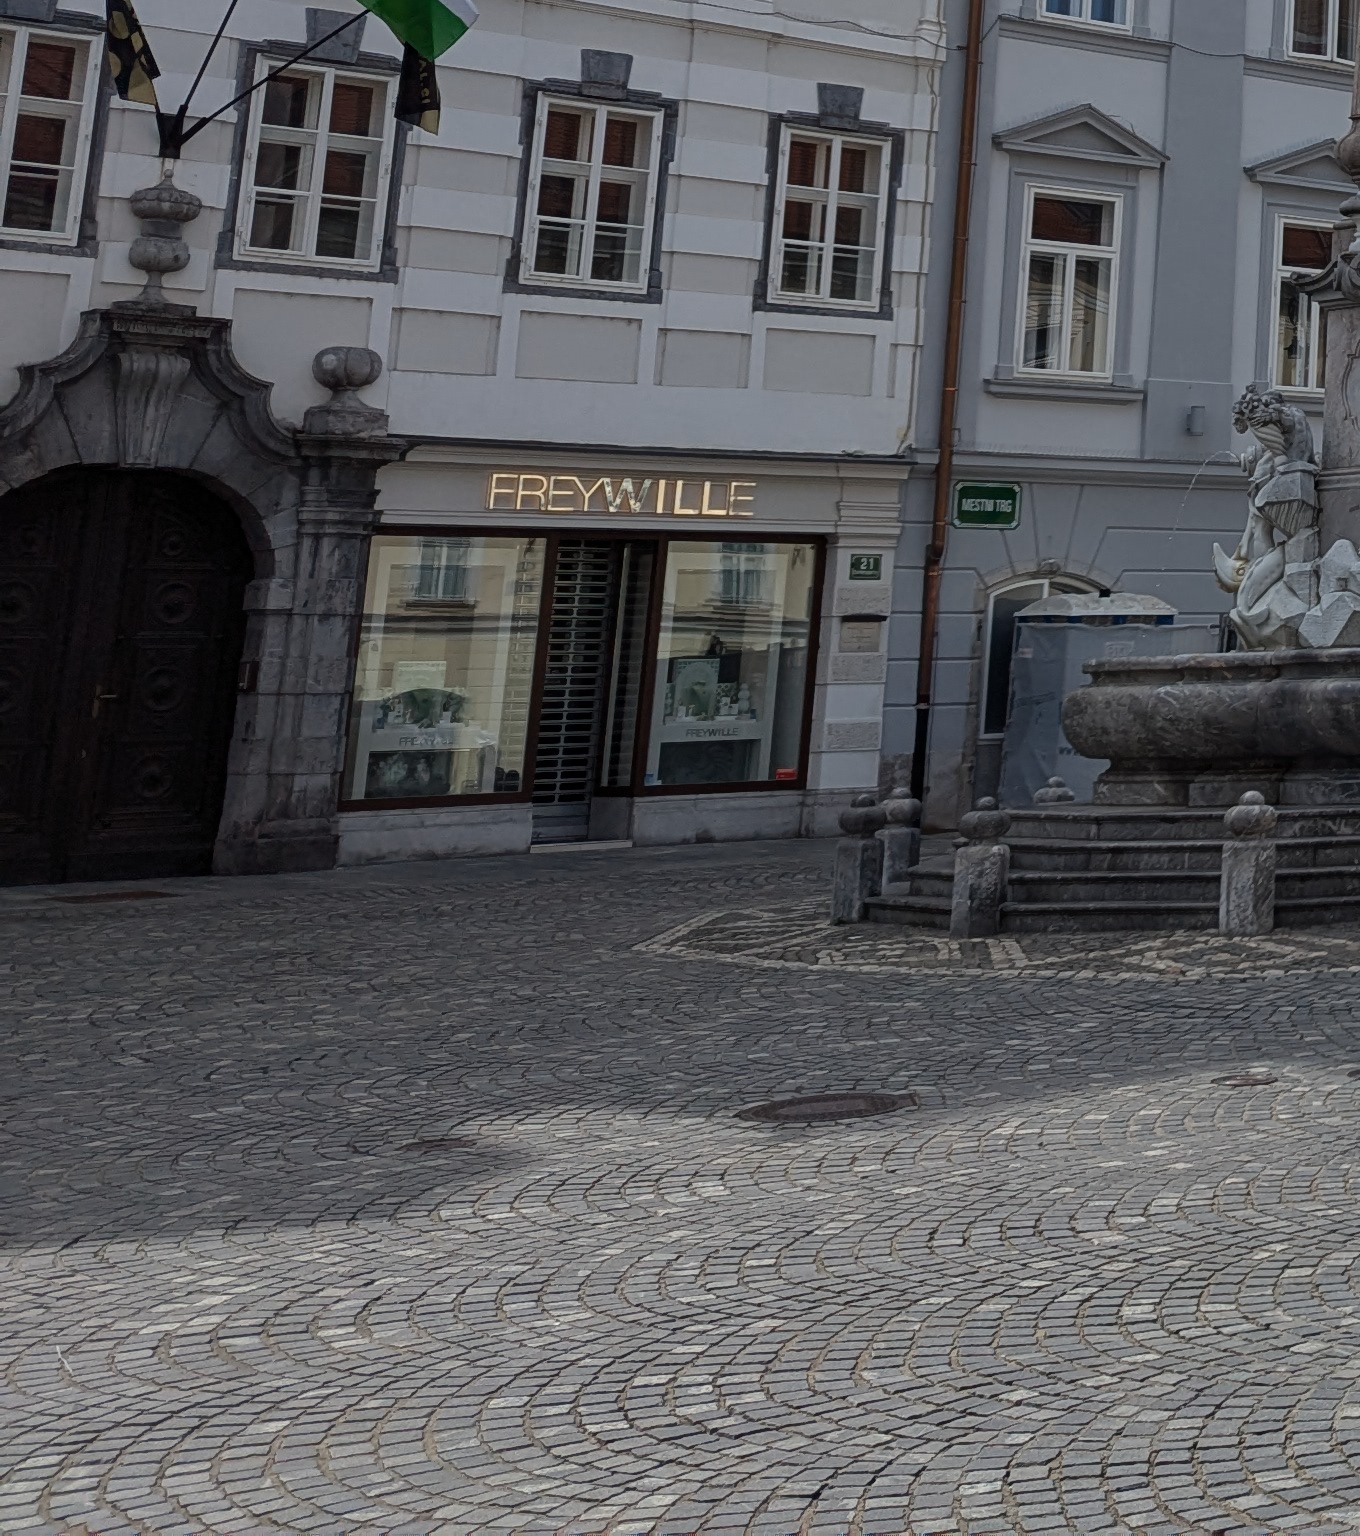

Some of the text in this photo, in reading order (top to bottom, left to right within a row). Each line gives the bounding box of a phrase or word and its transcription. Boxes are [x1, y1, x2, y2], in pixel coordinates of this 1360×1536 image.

[488, 473, 757, 515] FREYWILLE
[961, 498, 1012, 512] MESTNI TRG
[860, 557, 874, 570] 21
[685, 727, 739, 738] FREYWILLE
